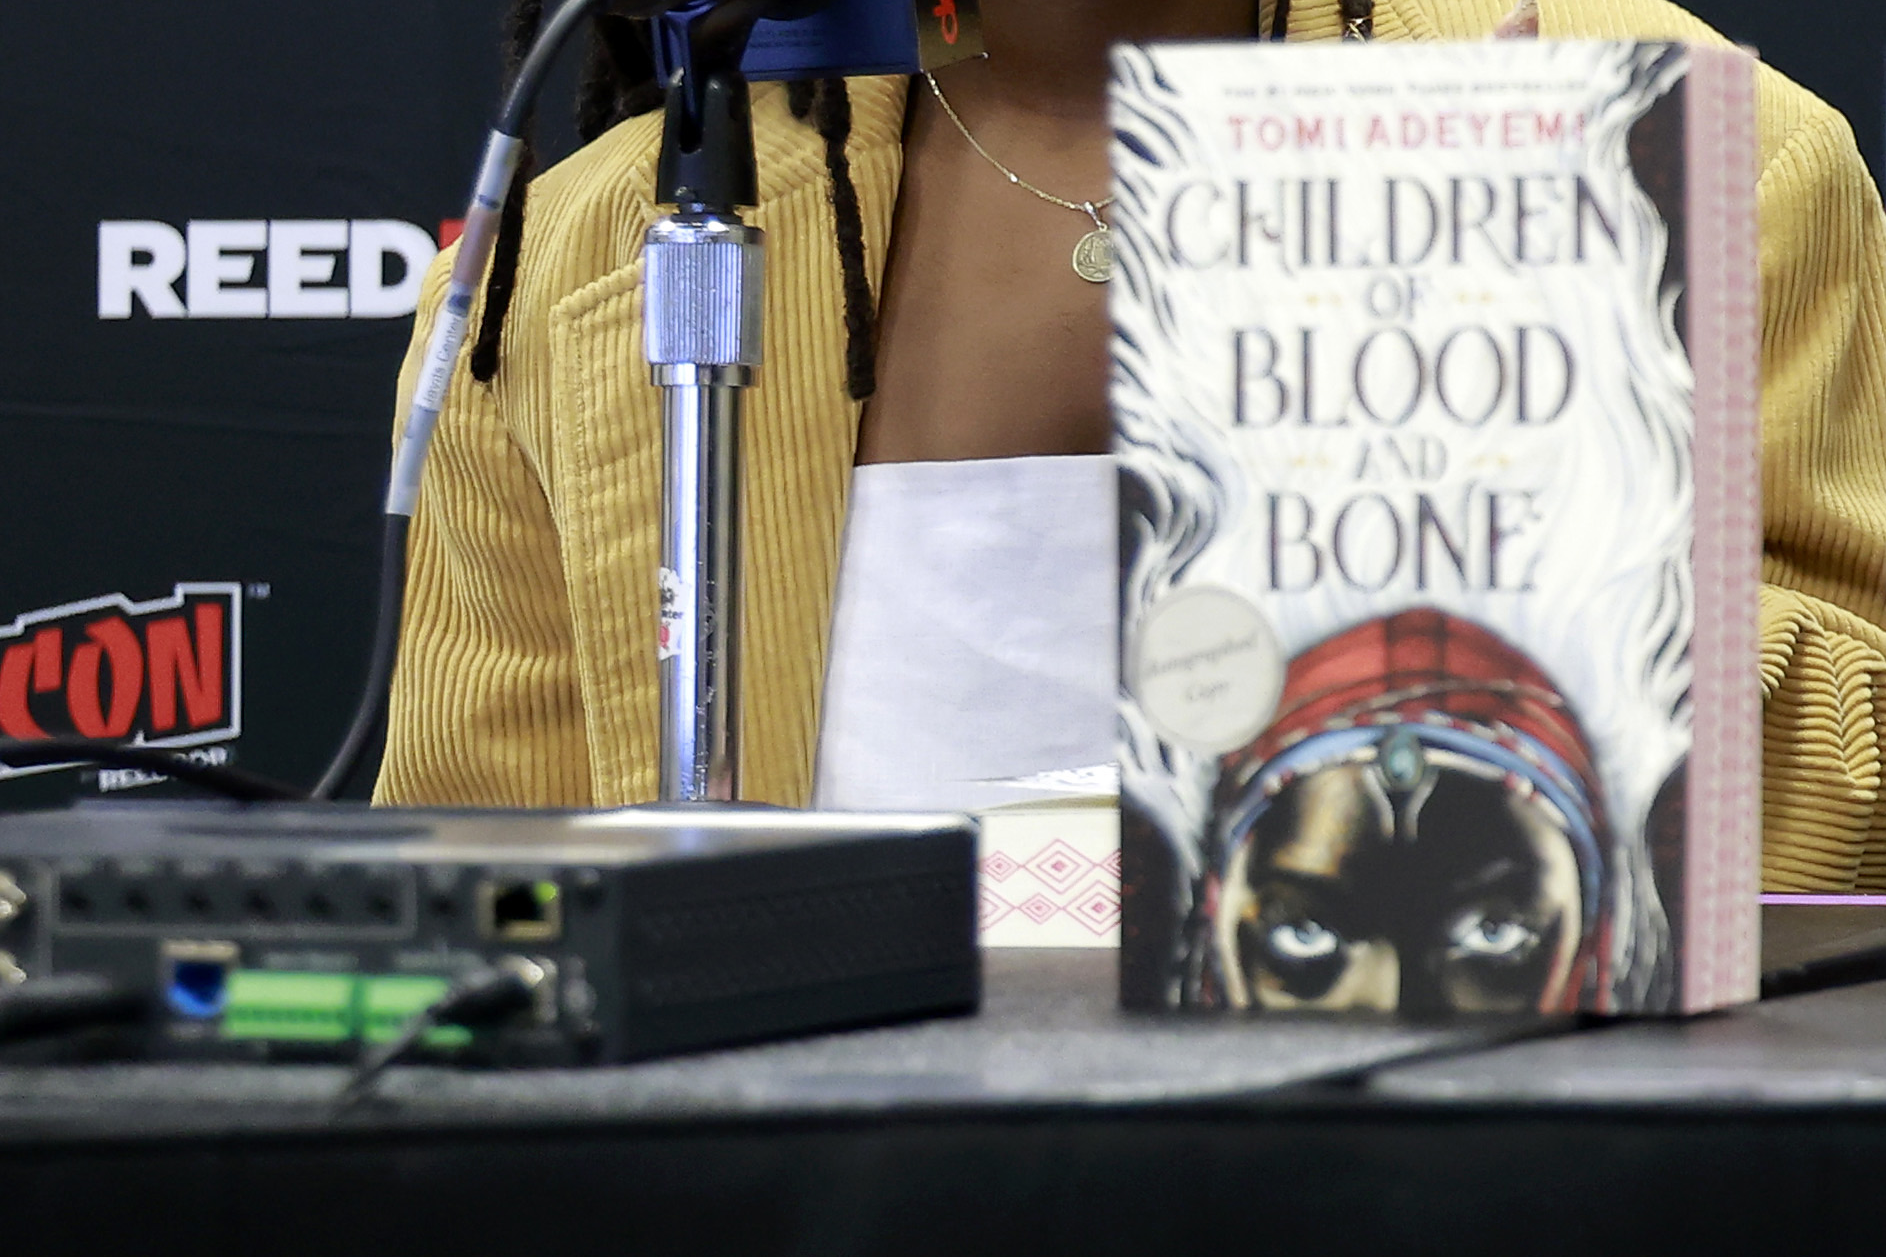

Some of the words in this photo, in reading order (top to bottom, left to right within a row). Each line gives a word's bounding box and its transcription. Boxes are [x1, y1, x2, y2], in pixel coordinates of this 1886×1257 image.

[1226, 114, 1346, 151] TOMI
[1364, 111, 1588, 151] ADEYEMI
[98, 219, 465, 320] REED
[1164, 173, 1624, 278] CHILDREN
[1364, 275, 1432, 324] OF
[1231, 324, 1577, 430] BLOOD
[1353, 435, 1449, 482] AND
[1265, 483, 1545, 594] BONE
[0, 603, 223, 740] CON
